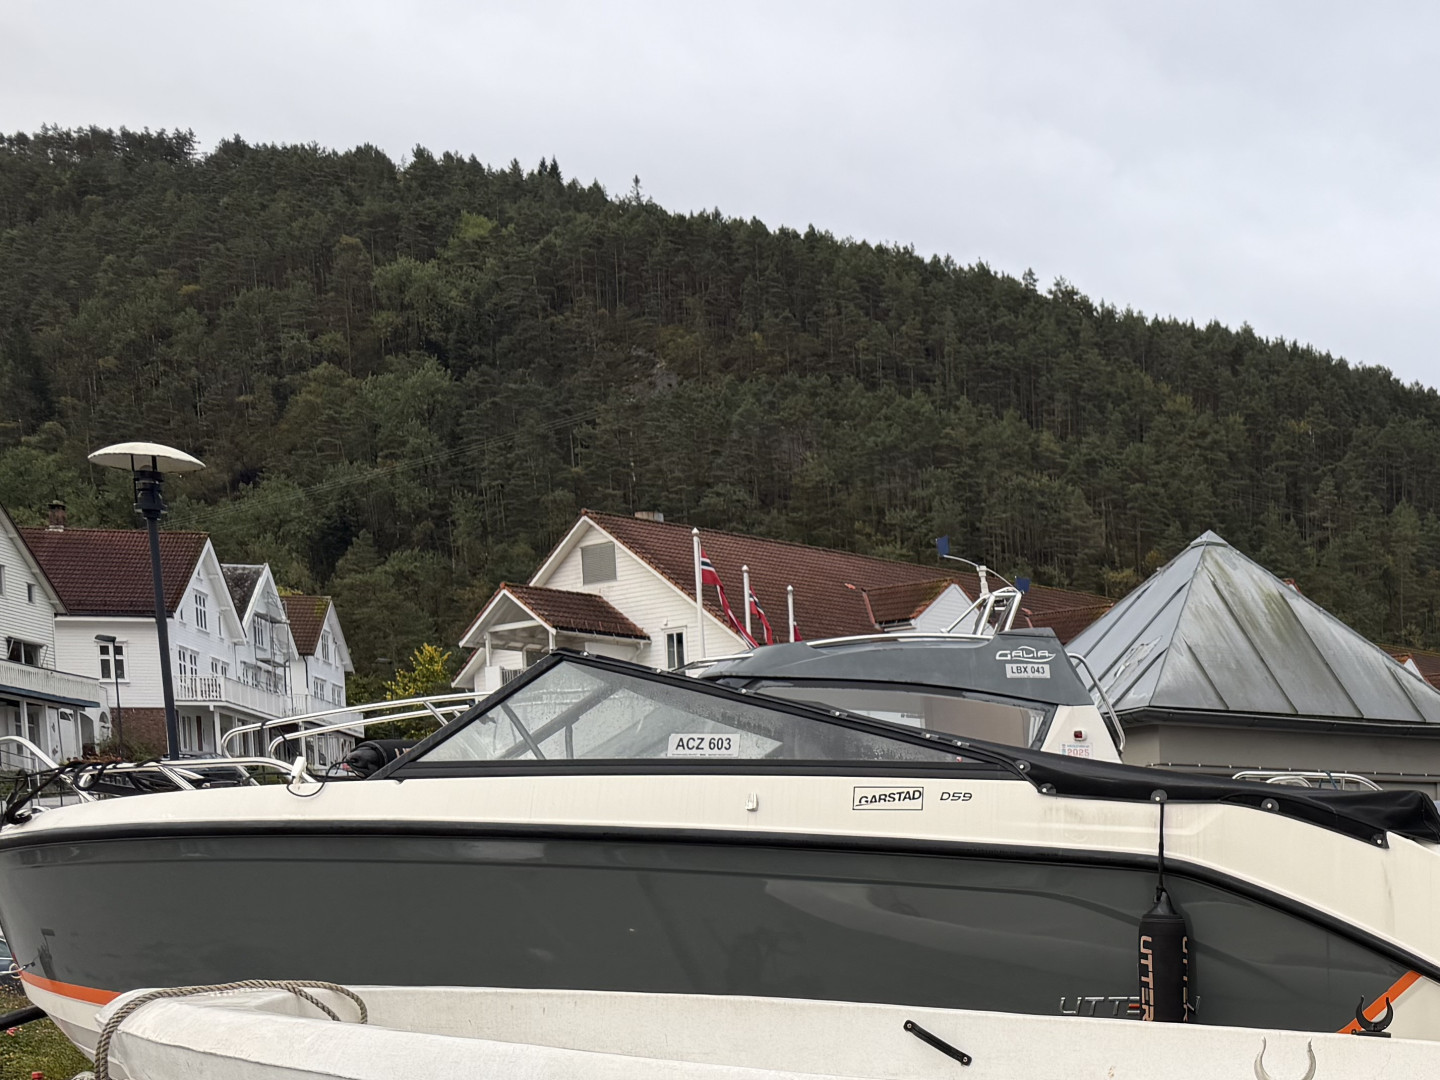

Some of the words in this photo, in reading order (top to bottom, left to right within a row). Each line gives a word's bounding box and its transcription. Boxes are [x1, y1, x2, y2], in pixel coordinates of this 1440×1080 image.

[995, 648, 1053, 661] GALIA
[1010, 665, 1029, 675] LBX
[1030, 666, 1046, 675] 043
[675, 737, 705, 751] ACZ
[708, 737, 732, 751] 603
[1067, 748, 1090, 758] 2025
[857, 789, 922, 805] GARSTAD
